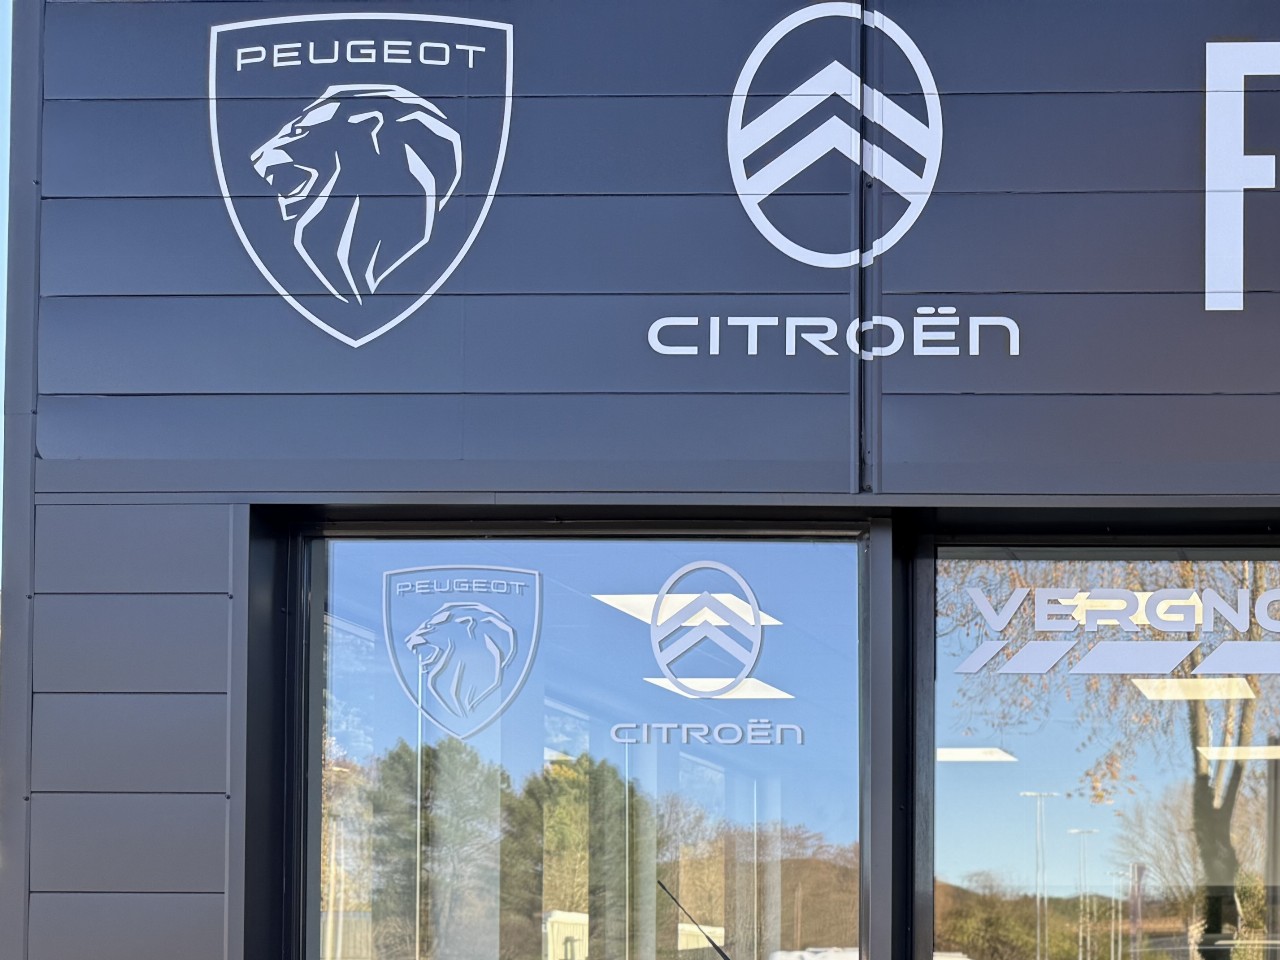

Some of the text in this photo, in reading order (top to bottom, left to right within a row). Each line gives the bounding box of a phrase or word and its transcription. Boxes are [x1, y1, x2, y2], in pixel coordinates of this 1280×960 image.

[236, 40, 486, 72] PEUGEOT
[647, 306, 1020, 361] CITROËN
[396, 578, 526, 596] PEUGEOT
[610, 719, 803, 744] CITROËN
